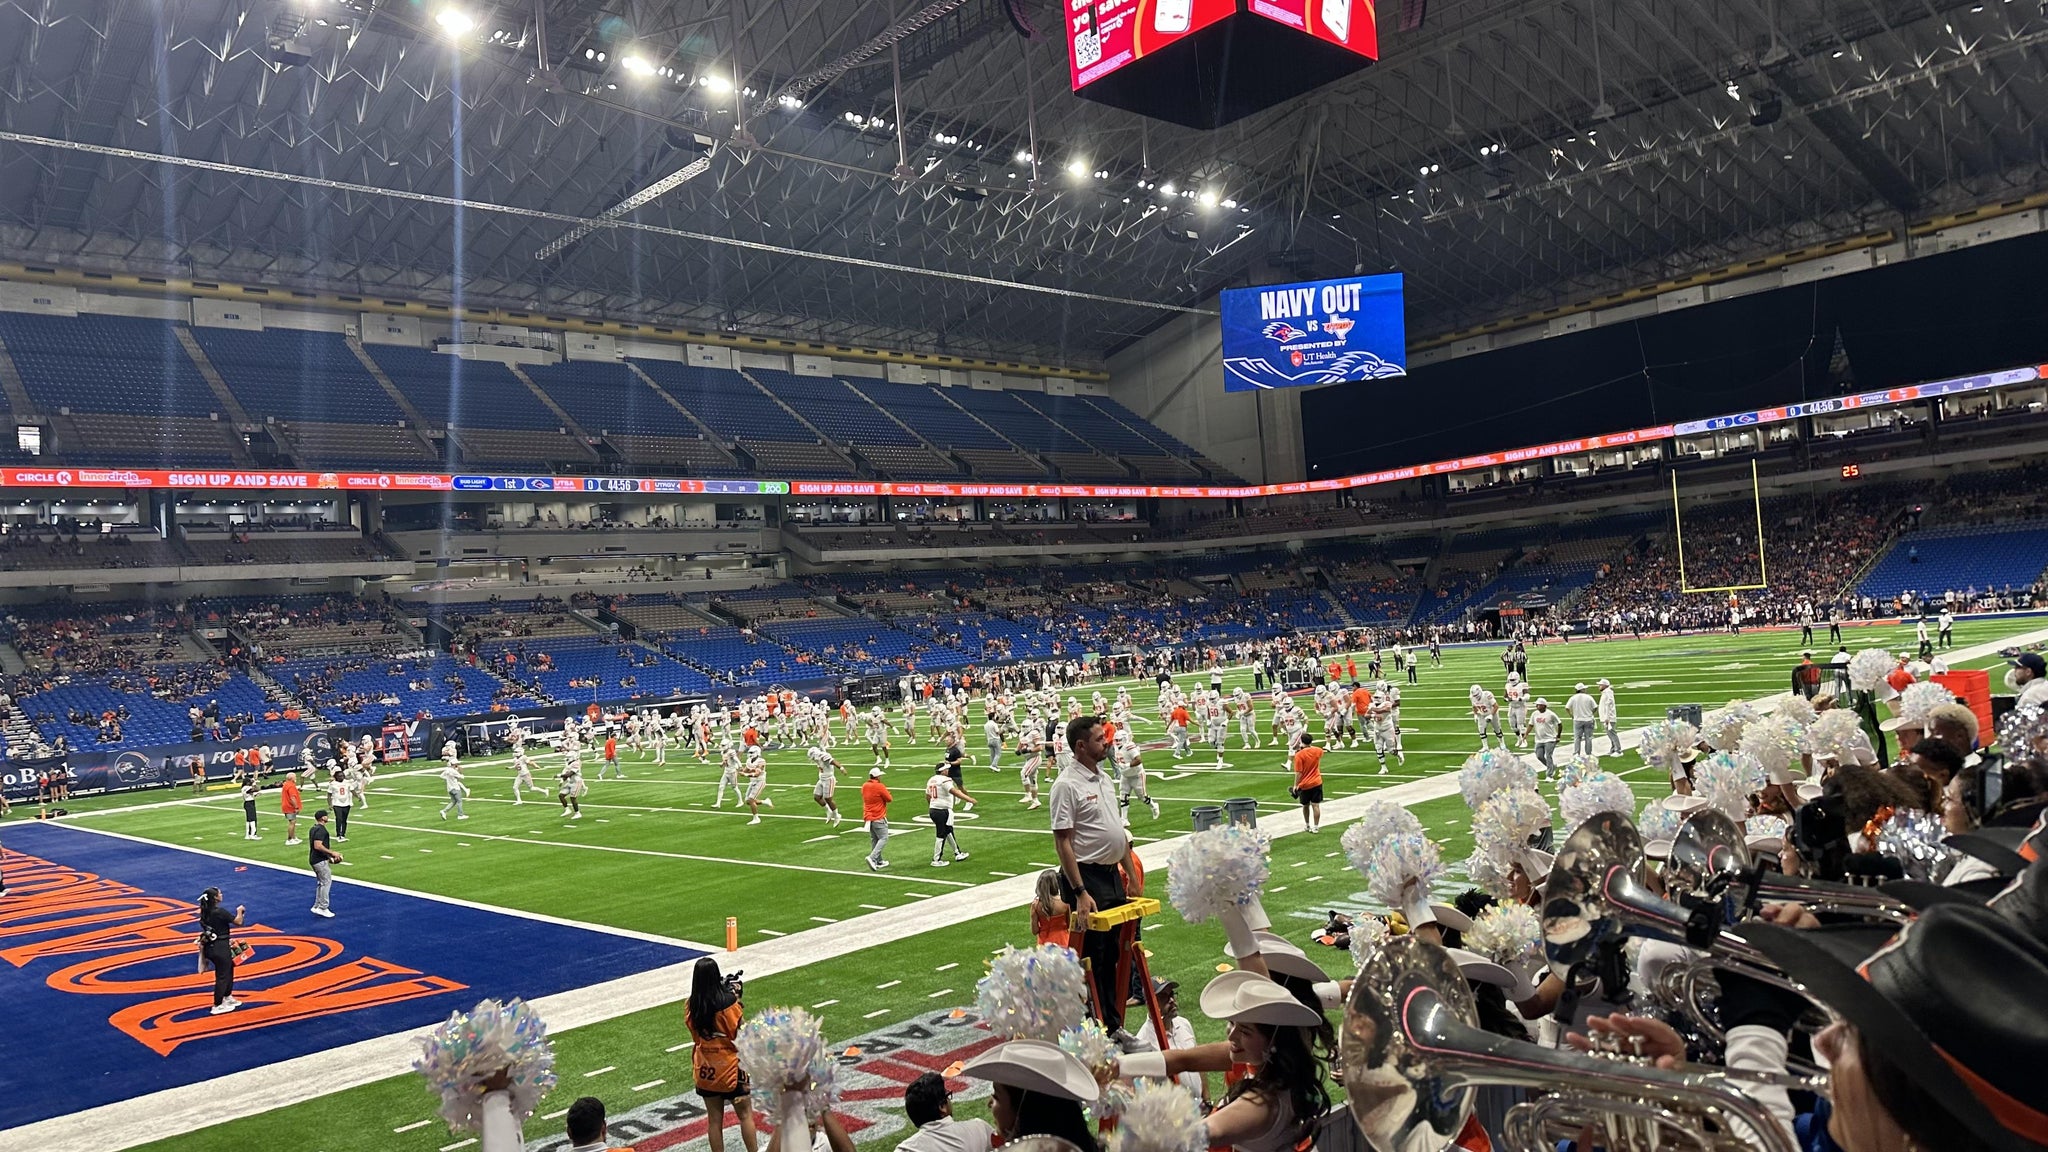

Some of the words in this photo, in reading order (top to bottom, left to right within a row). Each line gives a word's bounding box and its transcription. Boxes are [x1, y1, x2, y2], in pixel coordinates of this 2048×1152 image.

[1261, 288, 1315, 320] NAVY
[1322, 283, 1362, 314] OUT
[1307, 320, 1318, 332] VS
[1280, 341, 1333, 352] PRESENTED
[1316, 351, 1336, 360] Health
[1849, 397, 1855, 406] 0
[1790, 407, 1795, 416] 0
[1810, 401, 1834, 414] 44:56
[1716, 419, 1726, 428] 1st
[1504, 451, 1524, 461] SIGN
[1525, 449, 1538, 459] UP
[1539, 446, 1557, 455] AND
[1559, 441, 1581, 452] SAVE
[1843, 465, 1858, 477] 25
[16, 473, 54, 482] CIRCLE
[79, 471, 138, 481] innercircle
[169, 474, 206, 485] SIGN
[209, 474, 231, 485] UP
[233, 475, 267, 486] AND
[269, 475, 307, 487] SAVE
[348, 477, 376, 486] CIRCLE
[1350, 476, 1367, 485] SIGN
[1367, 474, 1378, 482] UP
[1379, 472, 1395, 481] AND
[1395, 469, 1414, 478] SAVE
[503, 479, 516, 489] 1st
[588, 480, 593, 490] 0
[607, 480, 631, 491] 44:56
[644, 481, 650, 490] 0
[799, 484, 820, 493] SIGN
[821, 485, 833, 493] UP
[834, 485, 852, 493] AND
[854, 485, 875, 494] SAVE
[961, 486, 977, 494] SIGN
[1004, 487, 1023, 495] SAVE
[1095, 488, 1108, 496] SIGN
[1109, 488, 1118, 496] UP
[1119, 488, 1131, 496] AND
[1132, 488, 1147, 496] SAVE
[340, 787, 345, 795] 8
[700, 1065, 716, 1080] 62
